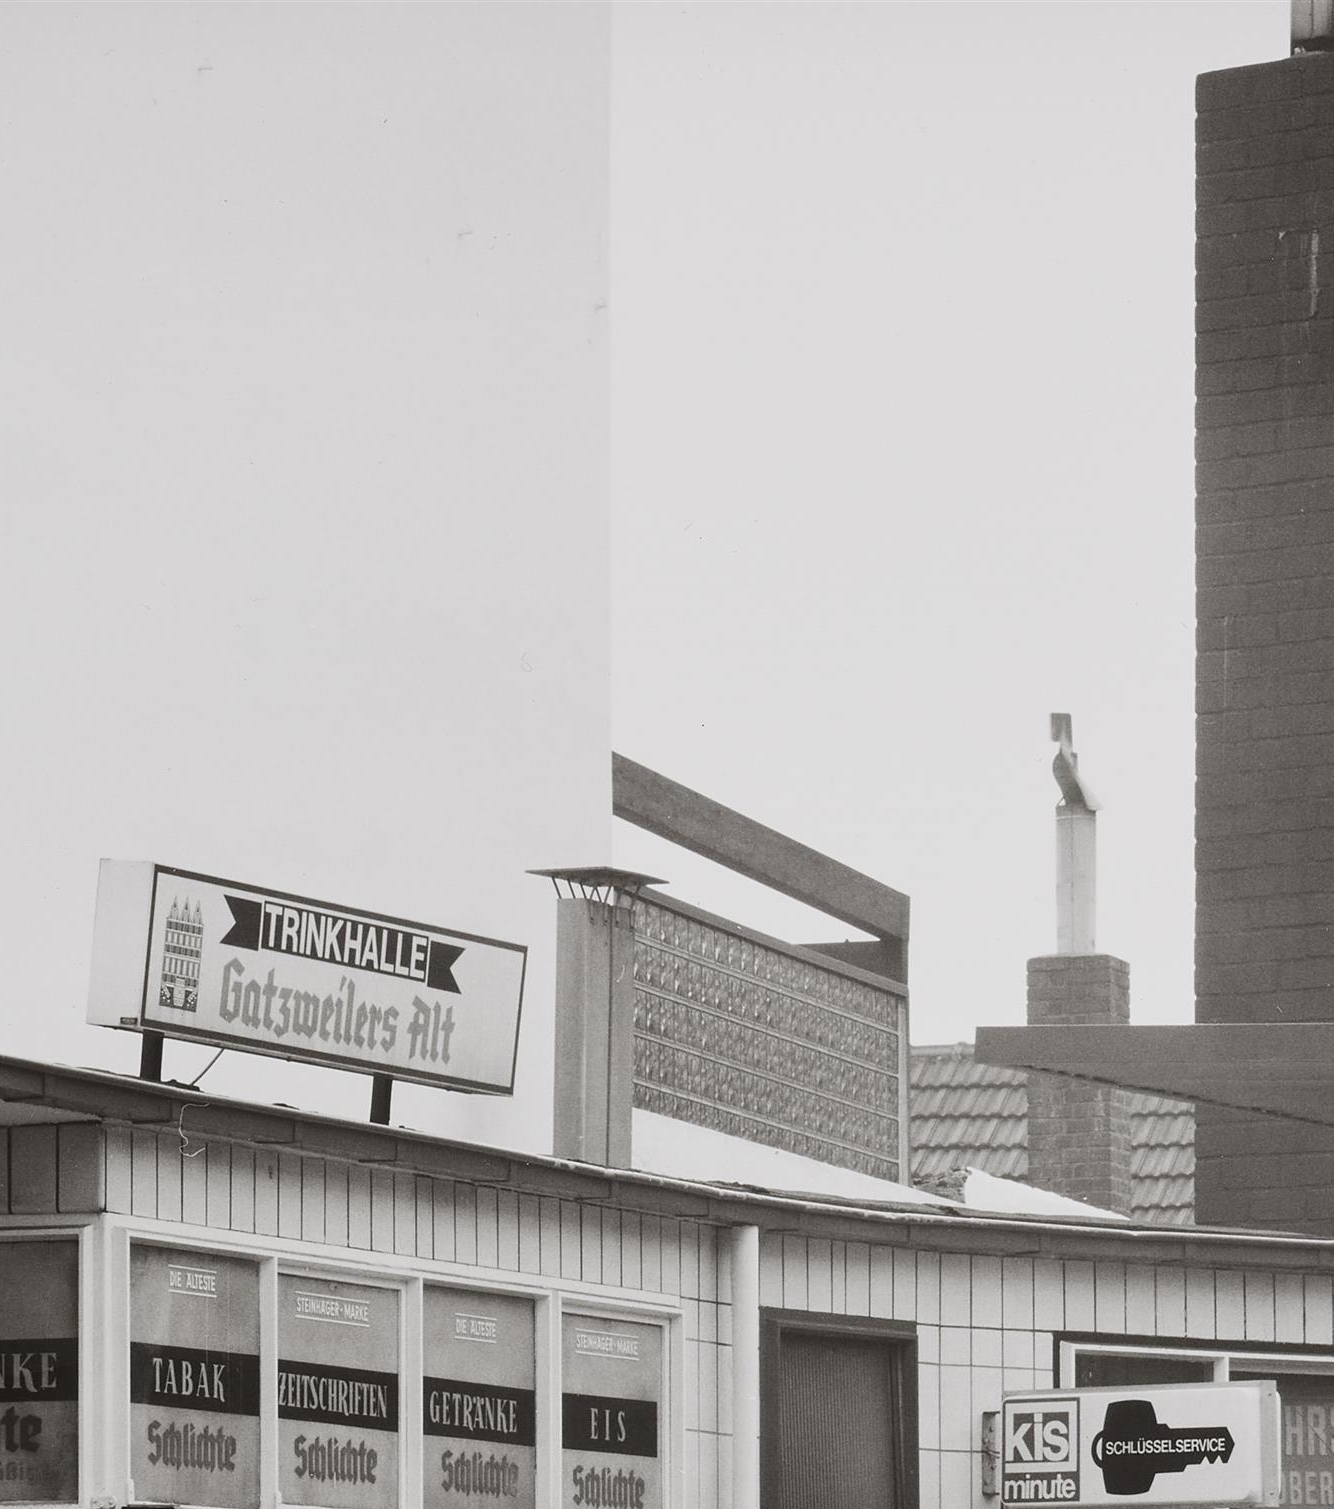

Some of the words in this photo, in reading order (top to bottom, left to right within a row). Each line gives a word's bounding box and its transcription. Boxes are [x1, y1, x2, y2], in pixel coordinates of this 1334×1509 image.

[265, 904, 428, 979] TRINKHALLE
[219, 957, 400, 1053] Gatzweilers
[407, 995, 456, 1064] Alt
[169, 1270, 183, 1289] DIE
[455, 1317, 468, 1335] DIE
[153, 1357, 226, 1403] TABAK
[278, 1371, 388, 1419] ZEITSCHRIFTEN
[429, 1390, 518, 1434] GETRÄNKE
[590, 1406, 626, 1443] EIS
[147, 1418, 237, 1474] Schlichte
[294, 1433, 378, 1486] Schlichte
[1105, 1436, 1226, 1456] SCHLÜSSELSERVICE
[441, 1448, 519, 1498] Schlichte
[1004, 1474, 1076, 1500] minute
